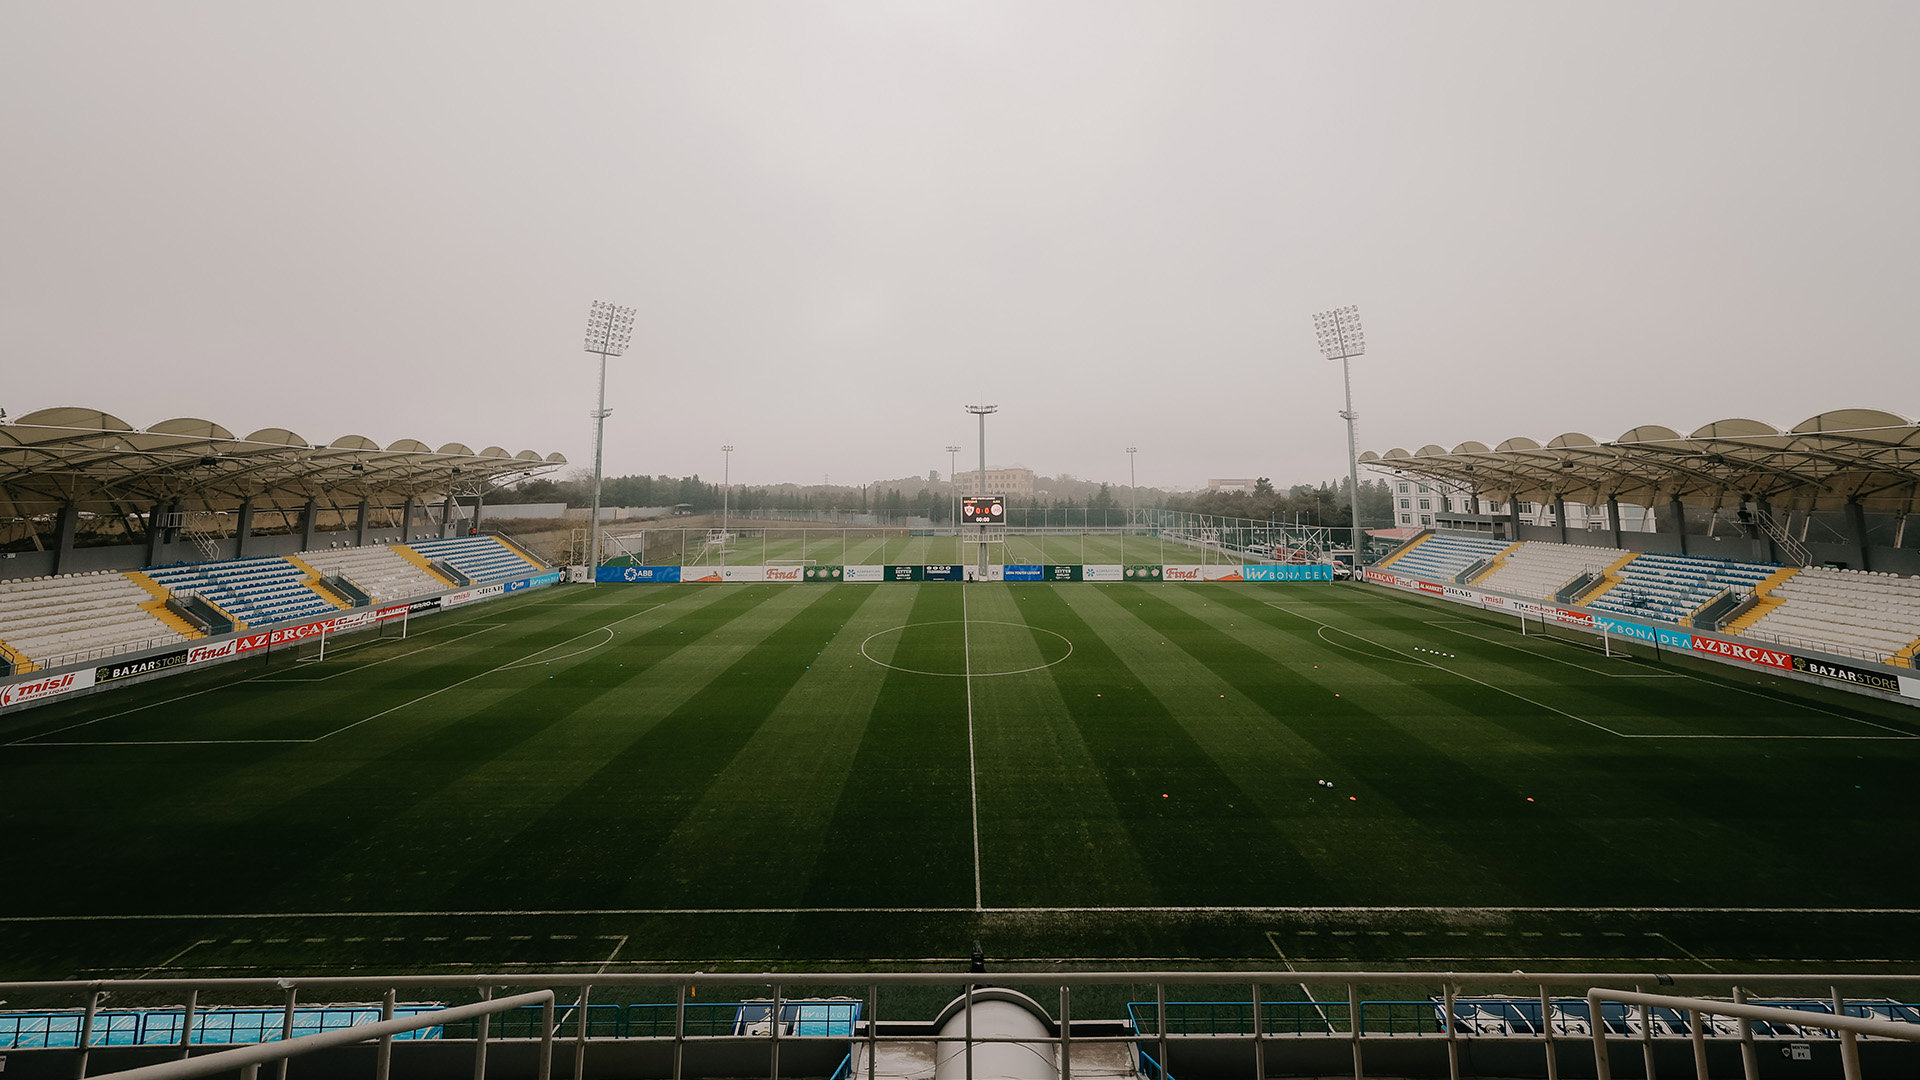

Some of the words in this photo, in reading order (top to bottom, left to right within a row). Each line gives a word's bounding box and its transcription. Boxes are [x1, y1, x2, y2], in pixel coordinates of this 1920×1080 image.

[637, 570, 653, 578] ABB
[766, 568, 800, 579] Final
[1166, 568, 1200, 579] Final
[477, 585, 503, 594] SIRAB
[1443, 586, 1471, 598] SIRAB
[1617, 625, 1656, 642] BONA
[1660, 634, 1692, 650] DEA
[189, 639, 236, 663] Final
[1693, 638, 1788, 669] AZERÇAY
[113, 654, 187, 679] BAZARSTORE
[1809, 663, 1898, 690] BAZARSTORE
[18, 674, 75, 697] misli
